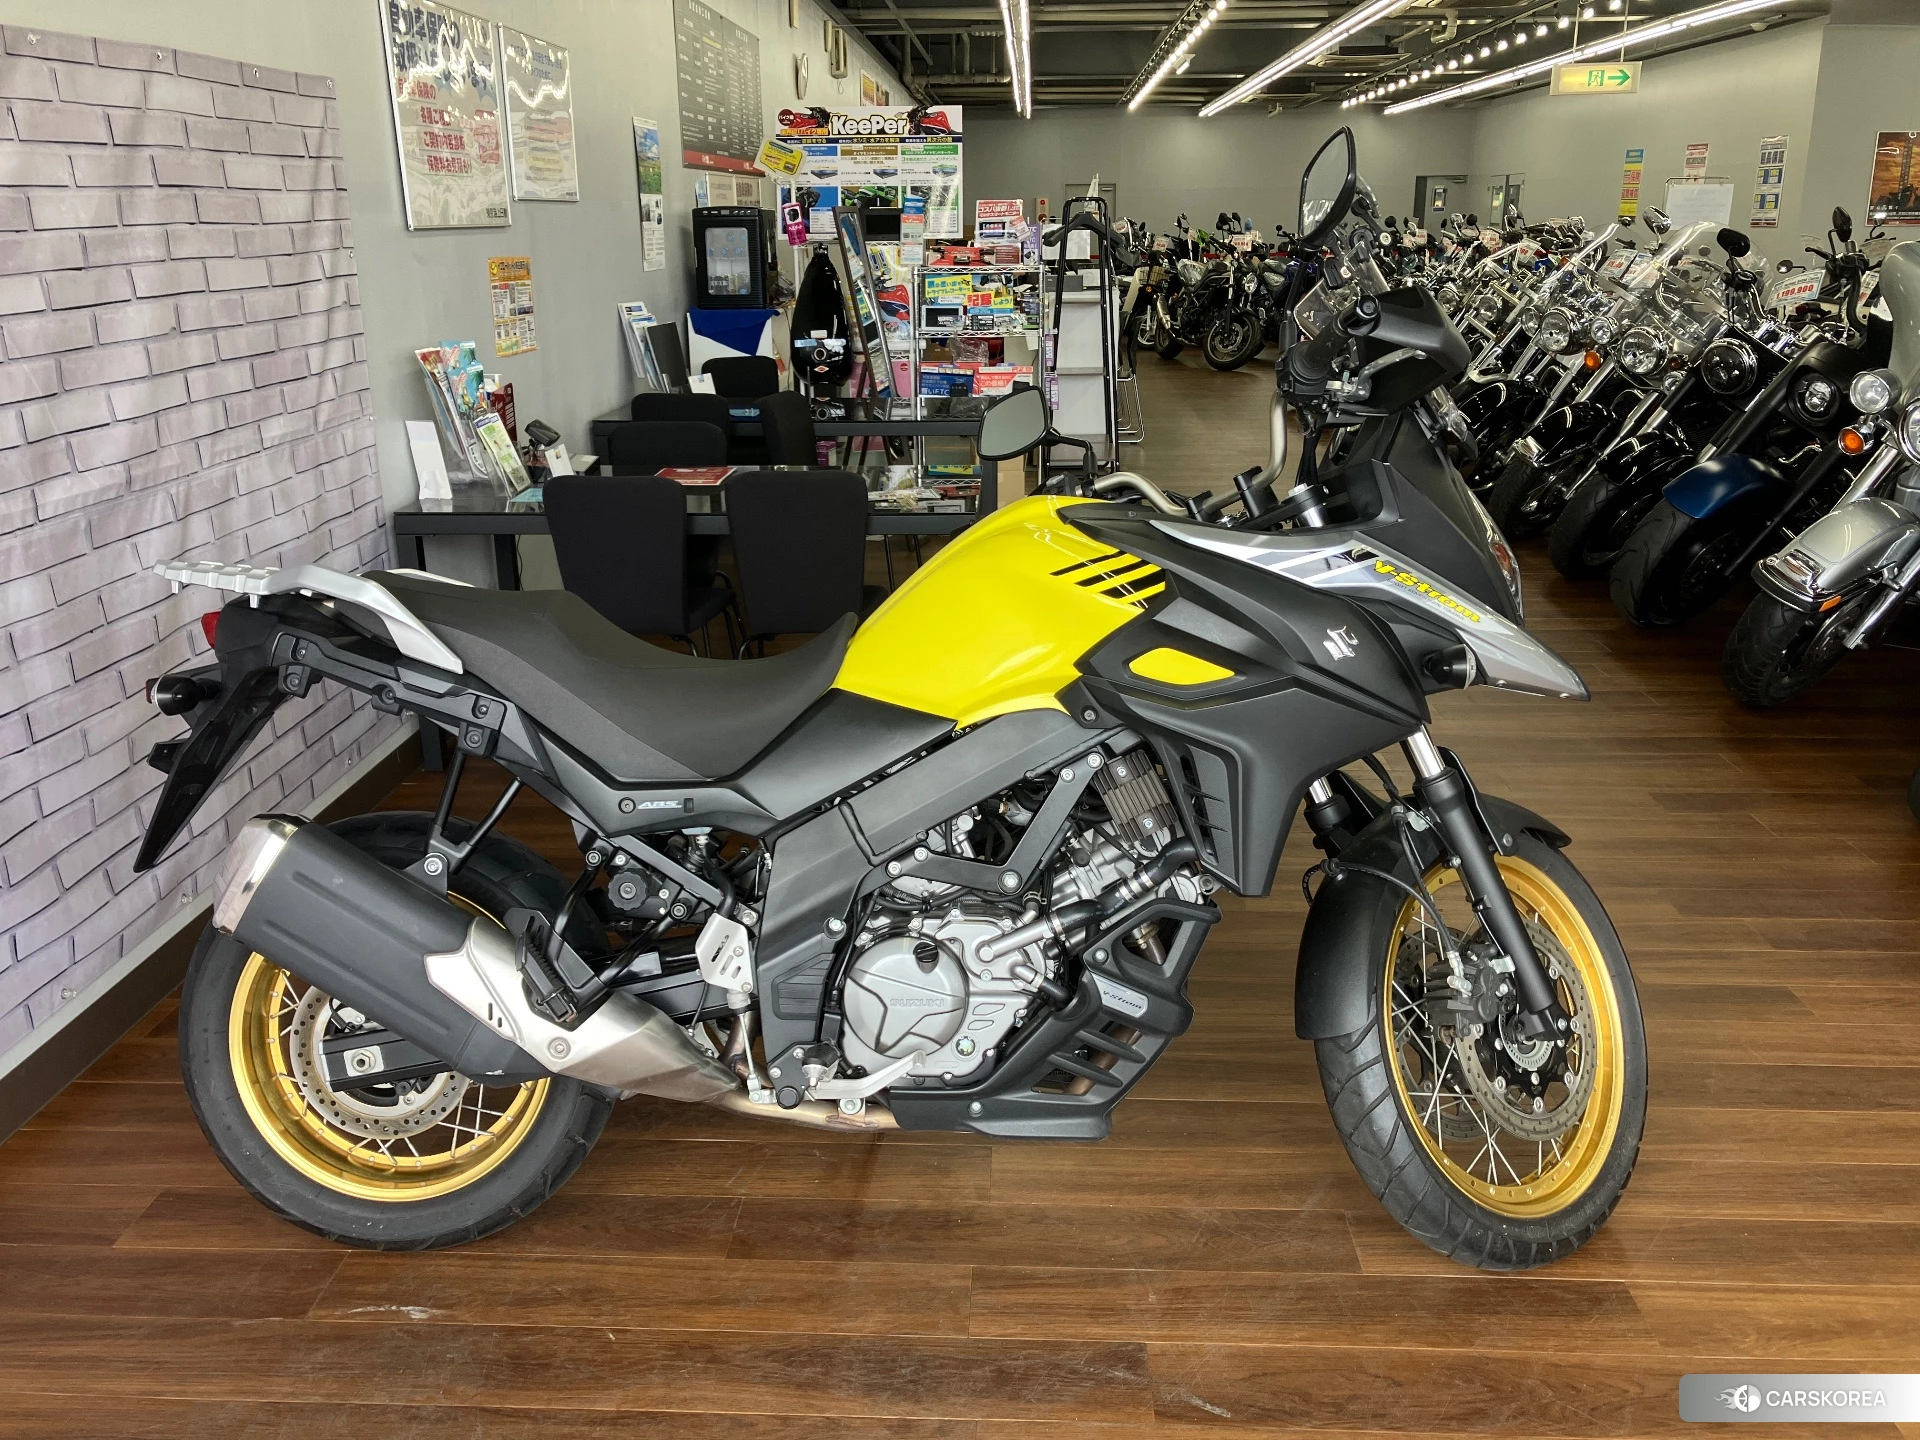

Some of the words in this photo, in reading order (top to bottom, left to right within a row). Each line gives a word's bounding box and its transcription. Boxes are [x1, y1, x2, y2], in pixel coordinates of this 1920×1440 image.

[832, 114, 907, 135] KeePer
[1374, 560, 1481, 623] V-Strom
[638, 800, 682, 810] ABS
[889, 998, 945, 1008] SUZUKI
